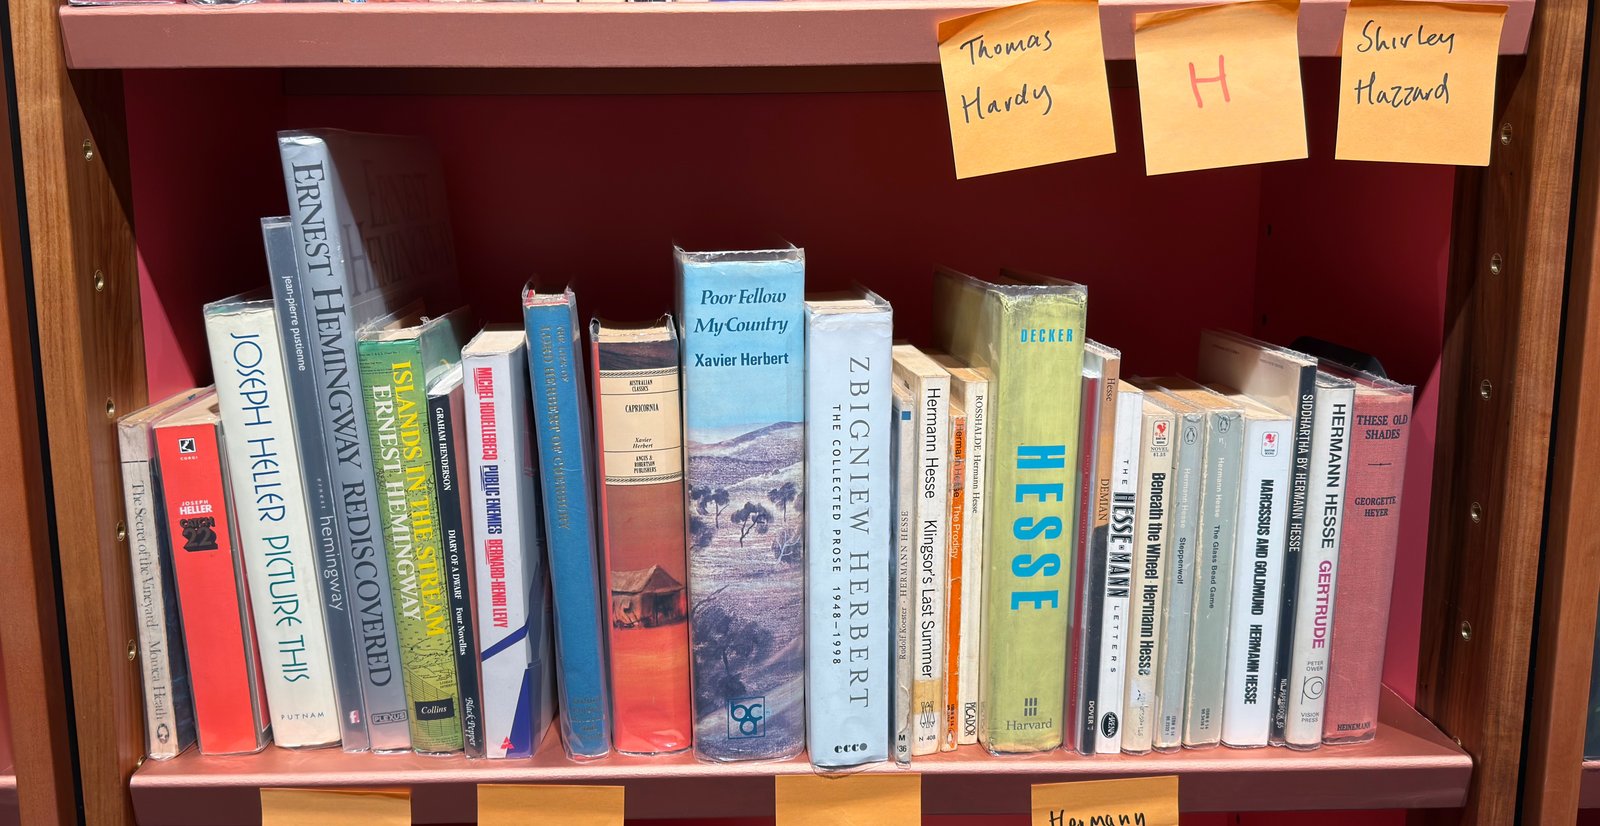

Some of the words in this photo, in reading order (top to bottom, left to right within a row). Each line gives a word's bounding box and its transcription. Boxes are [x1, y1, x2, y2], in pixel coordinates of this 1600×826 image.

[960, 30, 1052, 64] Thomas
[1357, 20, 1455, 54] Shirley
[1188, 54, 1230, 108] H
[1354, 72, 1449, 108] Hazzard
[961, 84, 1052, 123] Hardy
[292, 160, 334, 276] ERNEST
[701, 290, 736, 305] Poor
[739, 288, 787, 304] Fellow
[282, 276, 298, 326] jean-pierre
[290, 327, 306, 372] pustienne
[694, 318, 724, 336] My
[726, 316, 788, 334] Country
[1020, 328, 1073, 343] DECKER
[695, 352, 737, 367] Xavier
[741, 352, 789, 366] Herbert
[230, 332, 272, 426] JOSEPH
[312, 285, 362, 470] HEMINGWAY
[477, 367, 494, 400] MICHEL
[1106, 378, 1116, 402] Hesse
[392, 360, 422, 461] ISLANDS
[436, 408, 446, 443] GRAHAM
[625, 404, 659, 413] CAPRICORNIA
[832, 404, 842, 430] THE
[926, 388, 941, 452] Hermann
[974, 395, 984, 452] ROSSHALDE
[1298, 394, 1314, 454] SIDDHARTHA
[1356, 414, 1388, 426] THESE
[1392, 414, 1408, 425] OLD
[372, 384, 402, 474] ERNEST
[480, 402, 498, 460] HOUELLEBECQ
[849, 356, 870, 534] ZBIGNIEW
[954, 423, 964, 468] Hermann
[1326, 404, 1346, 488] HERMANN
[1366, 429, 1400, 440] SHADES
[247, 437, 286, 522] HELLER
[406, 465, 427, 491] IN
[438, 444, 451, 490] HENDERSON
[484, 465, 500, 496] PUBLIC
[832, 440, 842, 520] COLLECTED
[924, 458, 939, 499] Hesse
[974, 454, 982, 490] Hermann
[1122, 460, 1130, 484] THE
[1217, 458, 1225, 492] Hermann
[1296, 457, 1310, 470] BY
[132, 481, 145, 506] The
[953, 468, 962, 498] Hesse
[1098, 478, 1110, 521] DEMIAN
[1150, 472, 1166, 520] Beneath
[1292, 474, 1306, 519] HERMANN
[1354, 496, 1396, 505] GEORGETTE
[135, 508, 147, 542] Secret
[180, 505, 213, 515] HELLER
[410, 494, 432, 541] THE
[486, 498, 502, 534] ENEMIES
[952, 505, 962, 523] The
[1257, 479, 1274, 536] NARCISSUS
[1322, 494, 1338, 548] HESSE
[1364, 508, 1389, 517] HEYER
[183, 526, 218, 552] 22
[448, 530, 458, 554] DIARY
[900, 510, 909, 542] HESSE
[951, 524, 962, 560] Prodigy
[1010, 444, 1066, 610] HESSE
[1148, 521, 1163, 542] the
[1288, 523, 1302, 552] HESSE
[138, 544, 150, 556] of
[140, 556, 152, 575] the
[319, 516, 344, 611] hemingway
[385, 480, 421, 620] HEMINGWAY
[450, 554, 458, 566] OF
[832, 529, 842, 572] PROSE
[920, 520, 938, 584] Klingsor's
[1145, 544, 1161, 580] Wheel
[1177, 538, 1186, 584] Steppenwolf
[1256, 538, 1269, 558] AND
[262, 535, 302, 627] PICTURE
[342, 480, 392, 688] REDISCOVERED
[453, 574, 462, 600] DWARF
[899, 544, 908, 596] HERMANN
[1210, 566, 1218, 586] Bead
[141, 577, 158, 628] Vineyard
[415, 546, 445, 637] STREAM
[922, 588, 936, 616] Last
[1251, 561, 1268, 616] GOLDMUND
[1312, 560, 1332, 649] GERTRUDE
[493, 608, 509, 628] LEVY
[899, 606, 907, 630] Koester
[1141, 584, 1158, 638] Hermann
[458, 626, 467, 656] Novellas
[849, 552, 870, 708] HERBERT
[899, 630, 907, 660] Rudolf
[1110, 605, 1120, 673] LETTERS
[149, 641, 162, 682] Monica
[279, 634, 310, 683] THIS
[921, 620, 935, 678] Summer
[1246, 624, 1262, 672] HERMANN
[152, 686, 169, 720] Heath
[1244, 674, 1258, 704] HESSE
[281, 712, 325, 720] PUTNAM
[421, 704, 448, 716] Collins
[465, 697, 476, 720] Black
[965, 702, 976, 737] PICADOR
[1006, 718, 1052, 732] Harvard
[465, 720, 476, 746] Pepper
[1337, 722, 1370, 731] HEINEMANN
[834, 742, 868, 754] ecco
